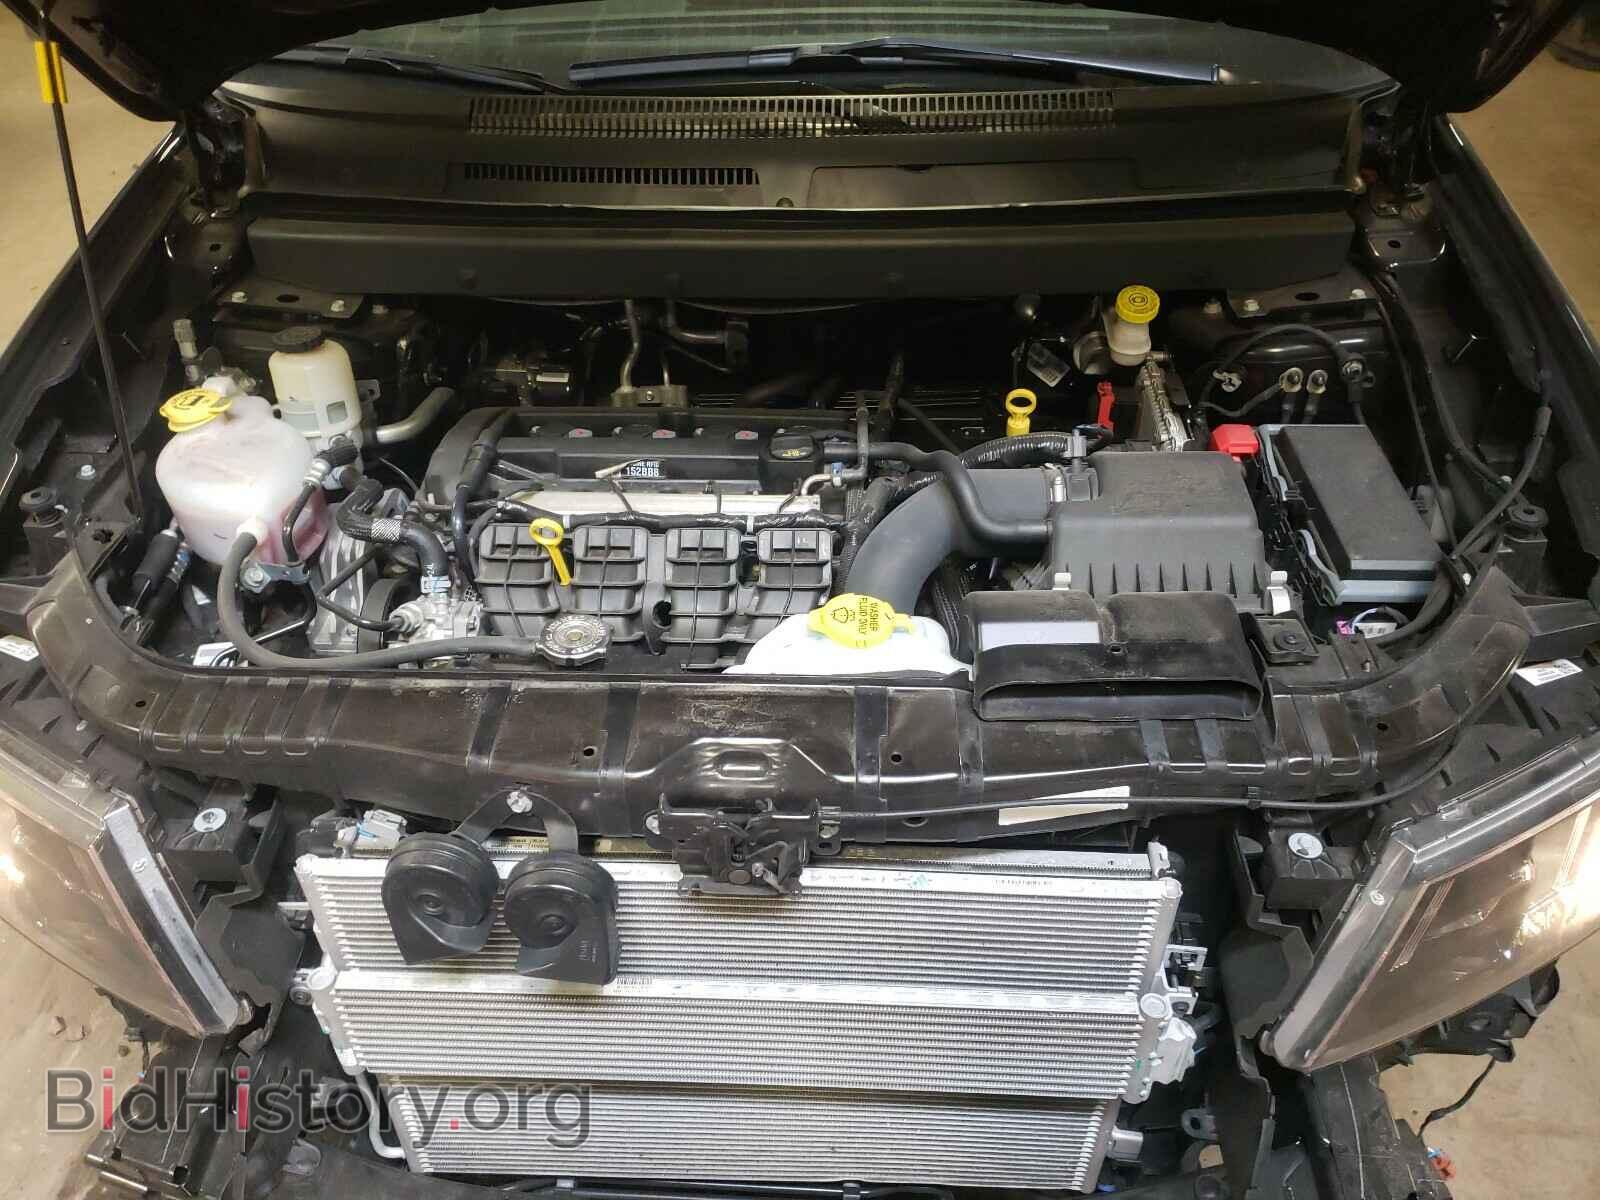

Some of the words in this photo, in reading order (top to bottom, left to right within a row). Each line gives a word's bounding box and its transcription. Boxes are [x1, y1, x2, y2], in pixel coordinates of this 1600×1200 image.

[859, 598, 868, 617] FLUID
[869, 602, 879, 631] WASHER
[859, 618, 868, 635] ONLY
